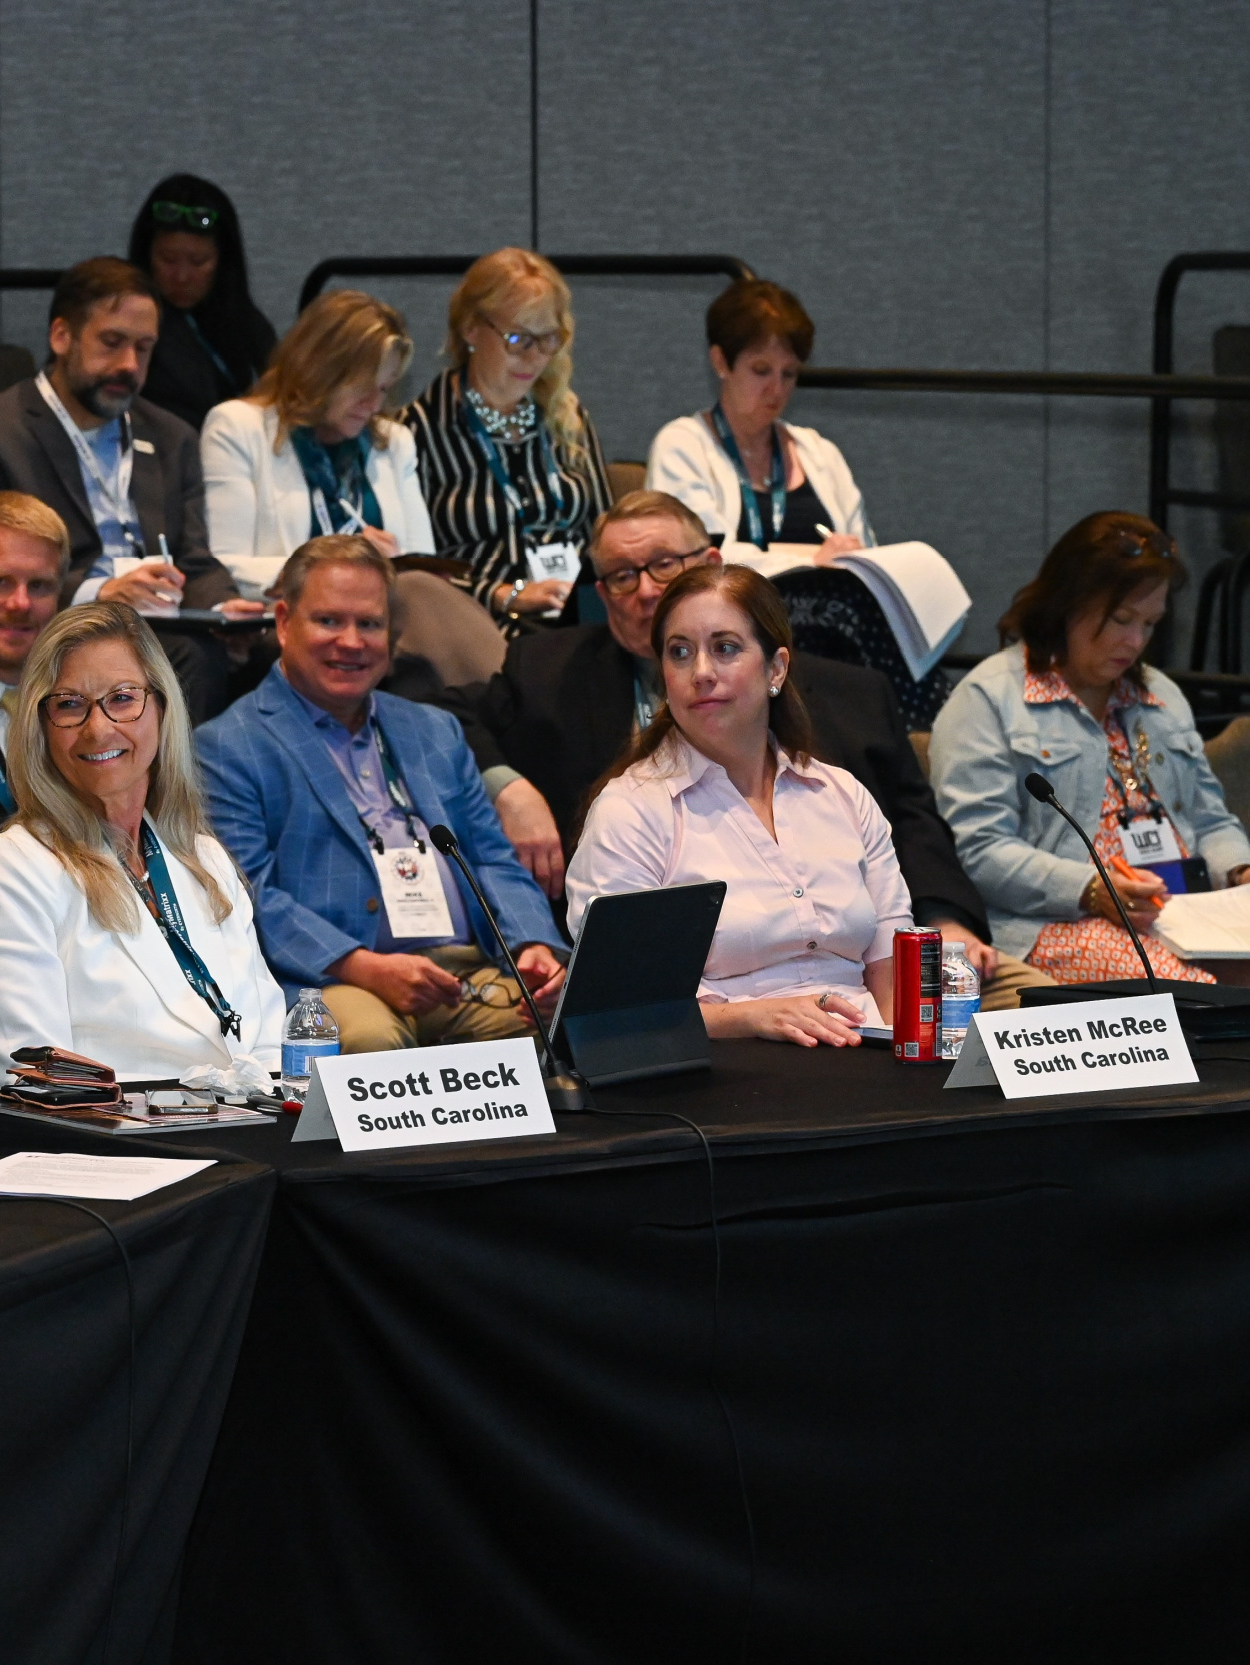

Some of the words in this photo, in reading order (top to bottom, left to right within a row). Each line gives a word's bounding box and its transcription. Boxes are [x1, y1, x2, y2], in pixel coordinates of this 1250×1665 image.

[994, 1027, 1082, 1050] Kristen
[1086, 1016, 1168, 1040] McRee
[1013, 1054, 1077, 1075] South
[1081, 1047, 1169, 1069] Carolina
[347, 1071, 433, 1101] Scott
[439, 1062, 521, 1093] Beck
[357, 1110, 426, 1132] South
[431, 1102, 528, 1125] Carolina
